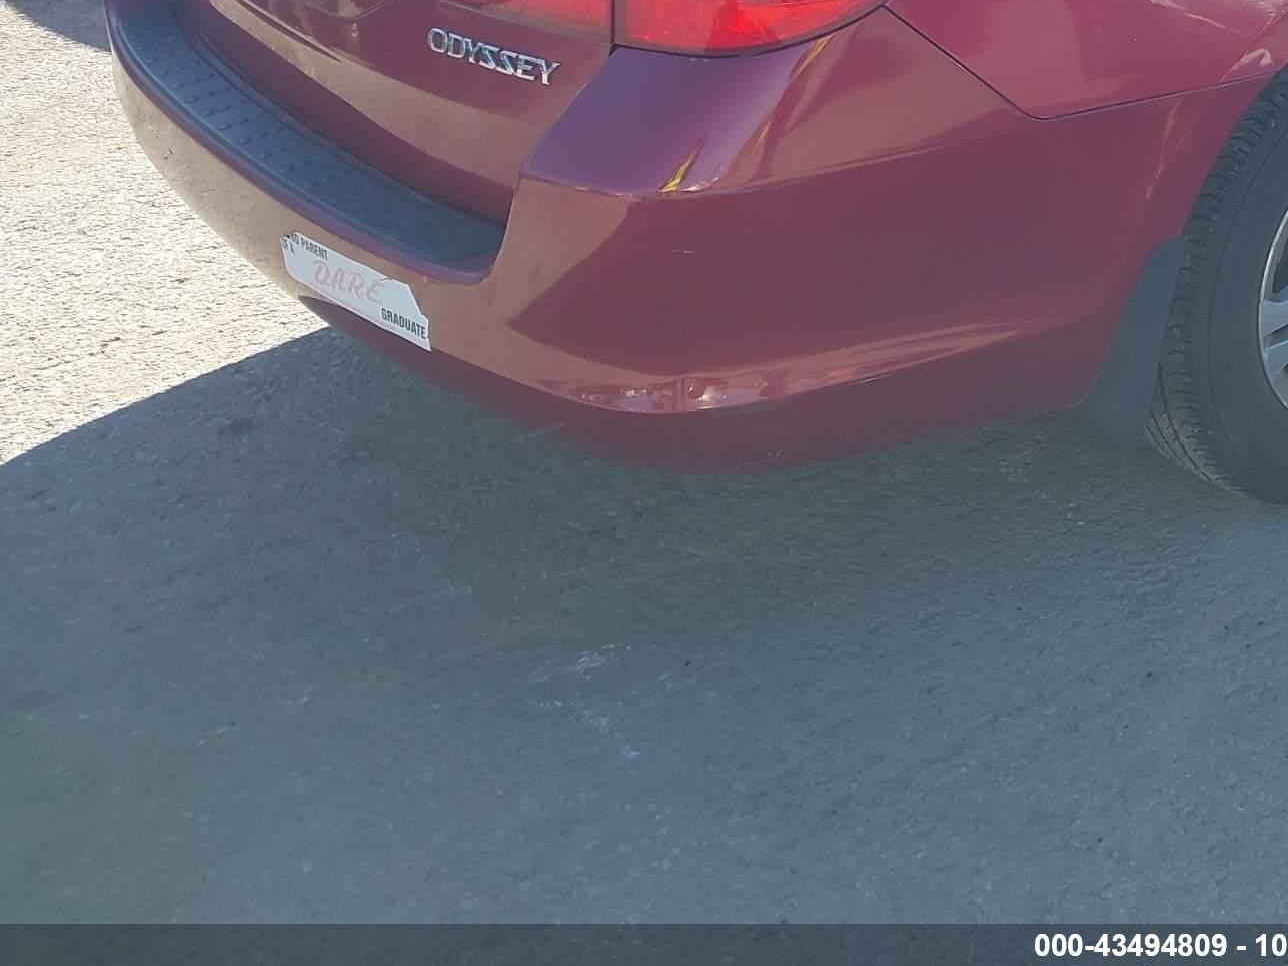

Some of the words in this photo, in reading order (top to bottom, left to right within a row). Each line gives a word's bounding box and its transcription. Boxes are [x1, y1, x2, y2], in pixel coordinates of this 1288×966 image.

[427, 27, 561, 86] ODYSSEY
[300, 238, 328, 261] PARENT
[381, 307, 427, 340] GRADUATE
